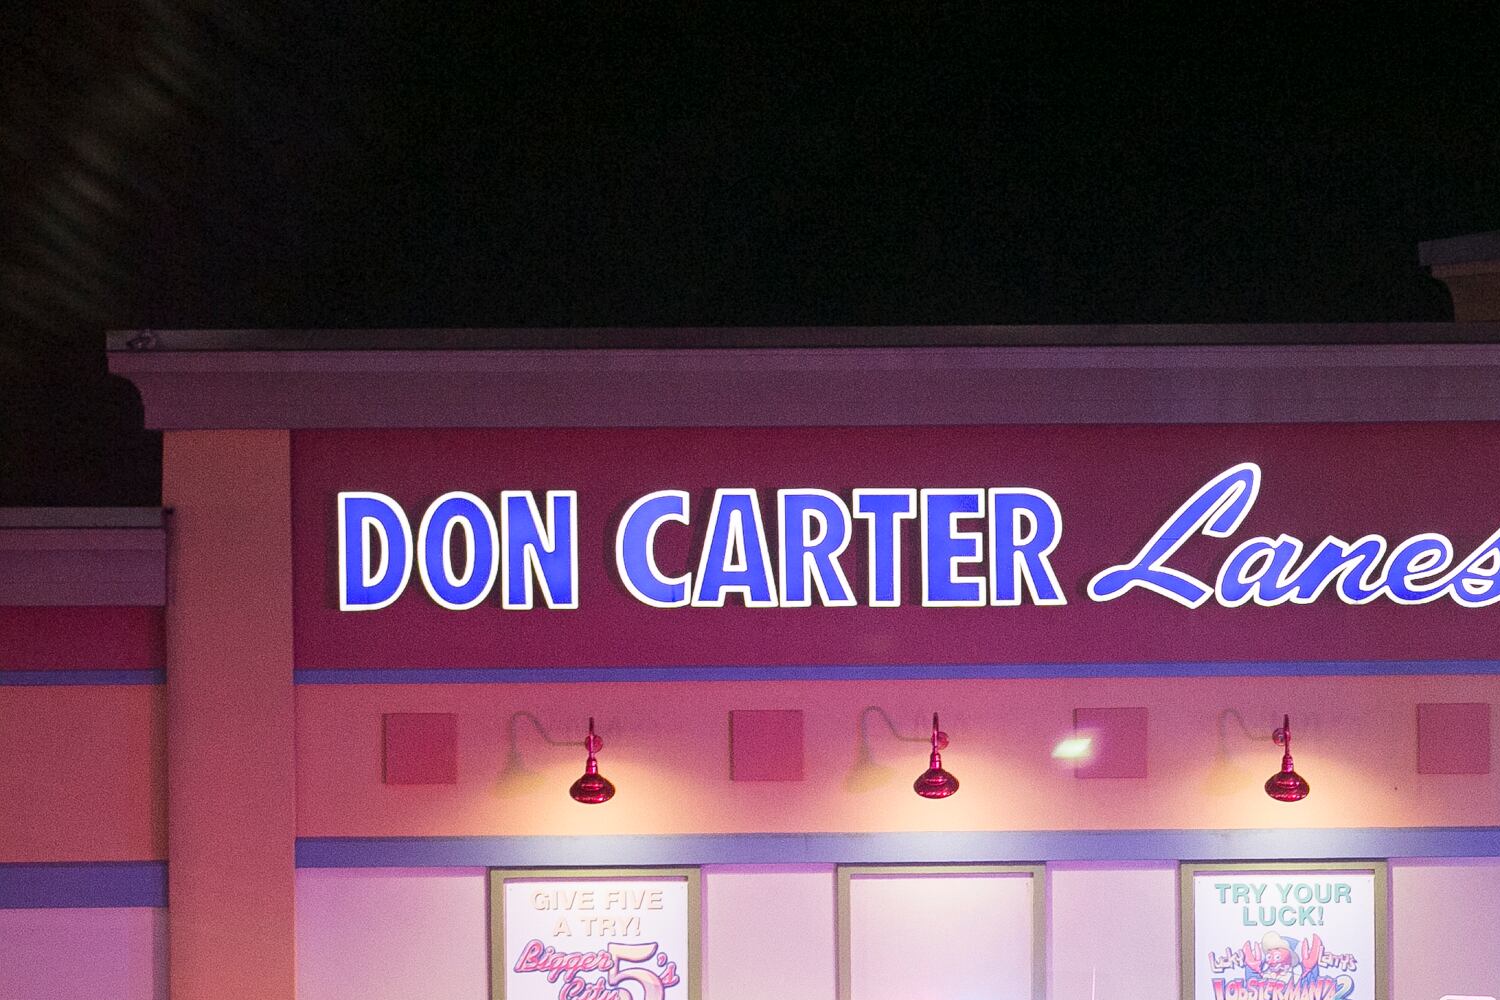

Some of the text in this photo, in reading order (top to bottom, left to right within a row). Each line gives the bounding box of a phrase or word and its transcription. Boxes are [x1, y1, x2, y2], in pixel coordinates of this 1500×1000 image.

[337, 490, 579, 611] DON
[615, 487, 1067, 609] CARTER
[533, 889, 663, 910] GIVE FIVE
[1215, 883, 1352, 903] TRY YOUR
[553, 917, 641, 936] A TRY!
[1243, 906, 1324, 926] LUCK!
[514, 939, 614, 983] Bigger
[1208, 947, 1245, 973] Lucky
